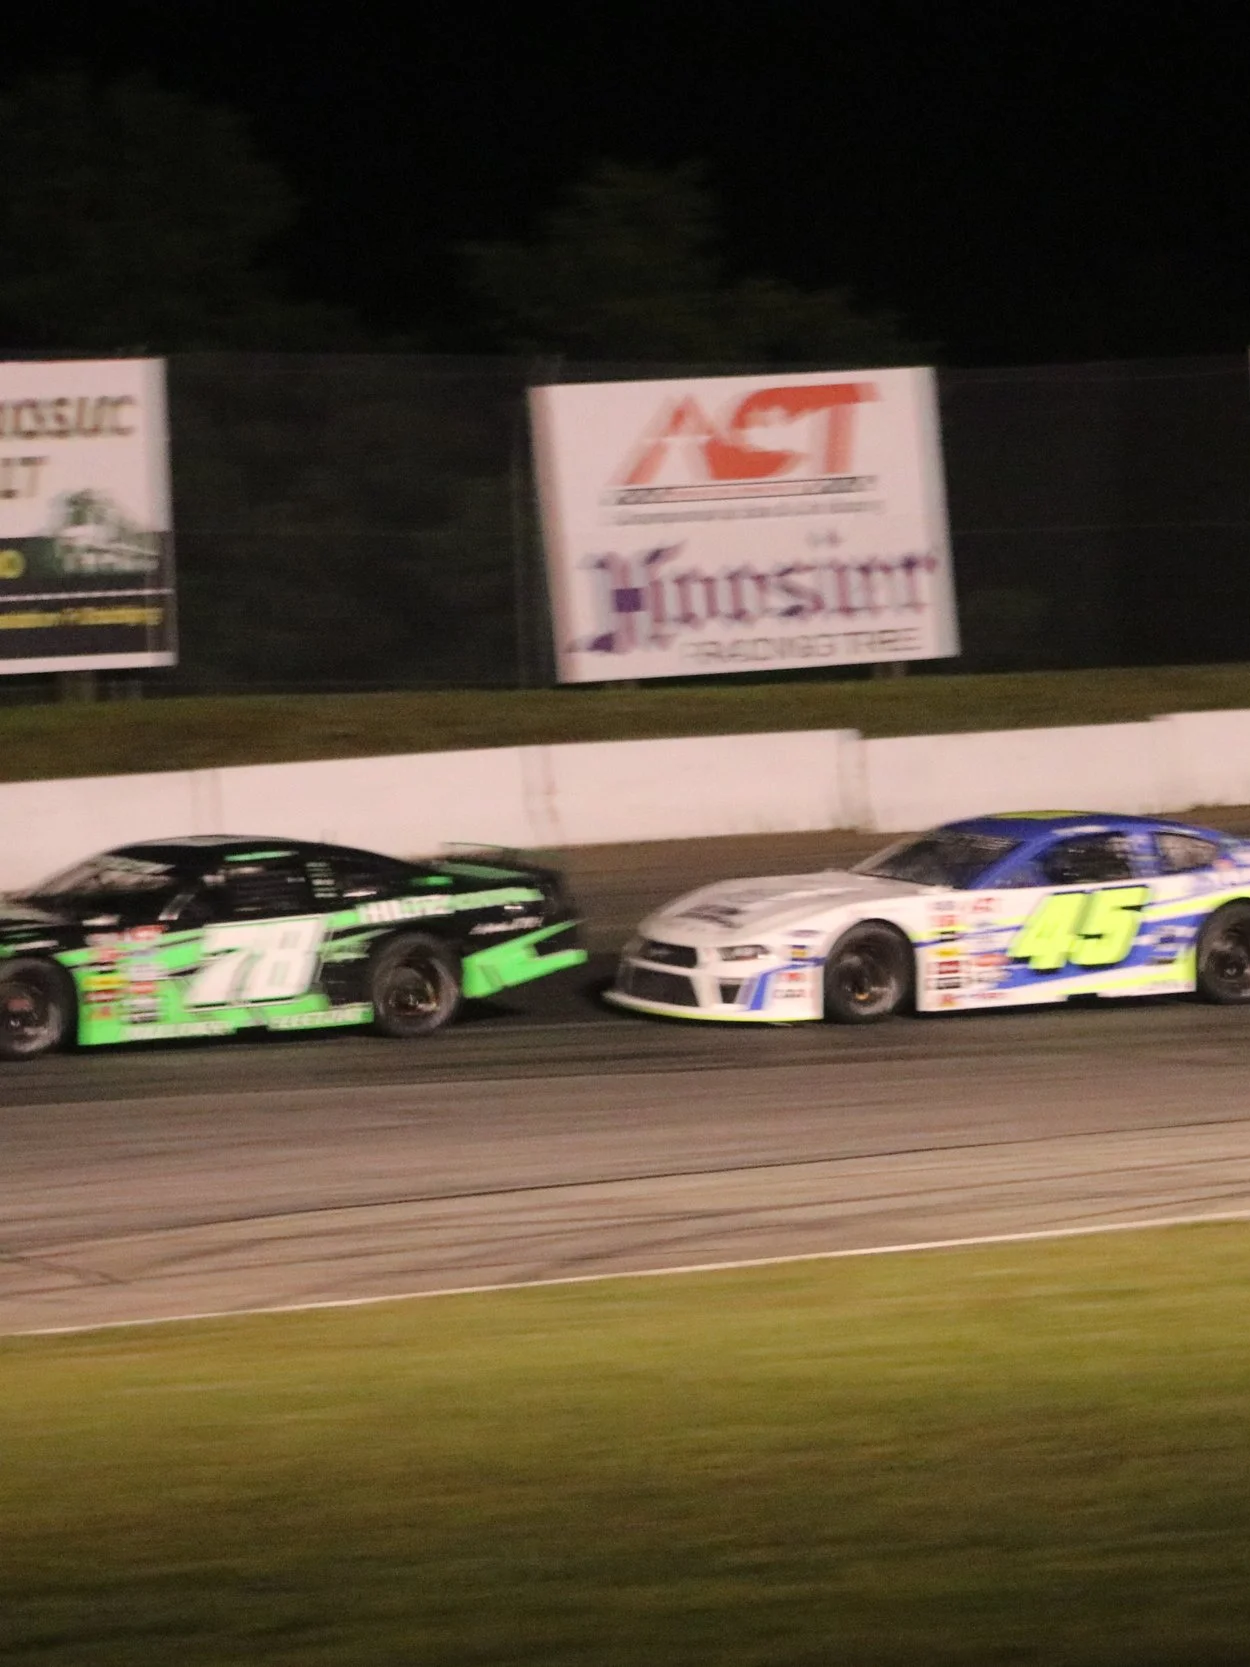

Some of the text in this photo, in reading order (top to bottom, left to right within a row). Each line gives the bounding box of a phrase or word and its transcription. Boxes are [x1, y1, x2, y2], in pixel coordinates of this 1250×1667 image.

[606, 381, 880, 488] ACT
[184, 913, 322, 1006] 78
[1008, 885, 1152, 973] 45
